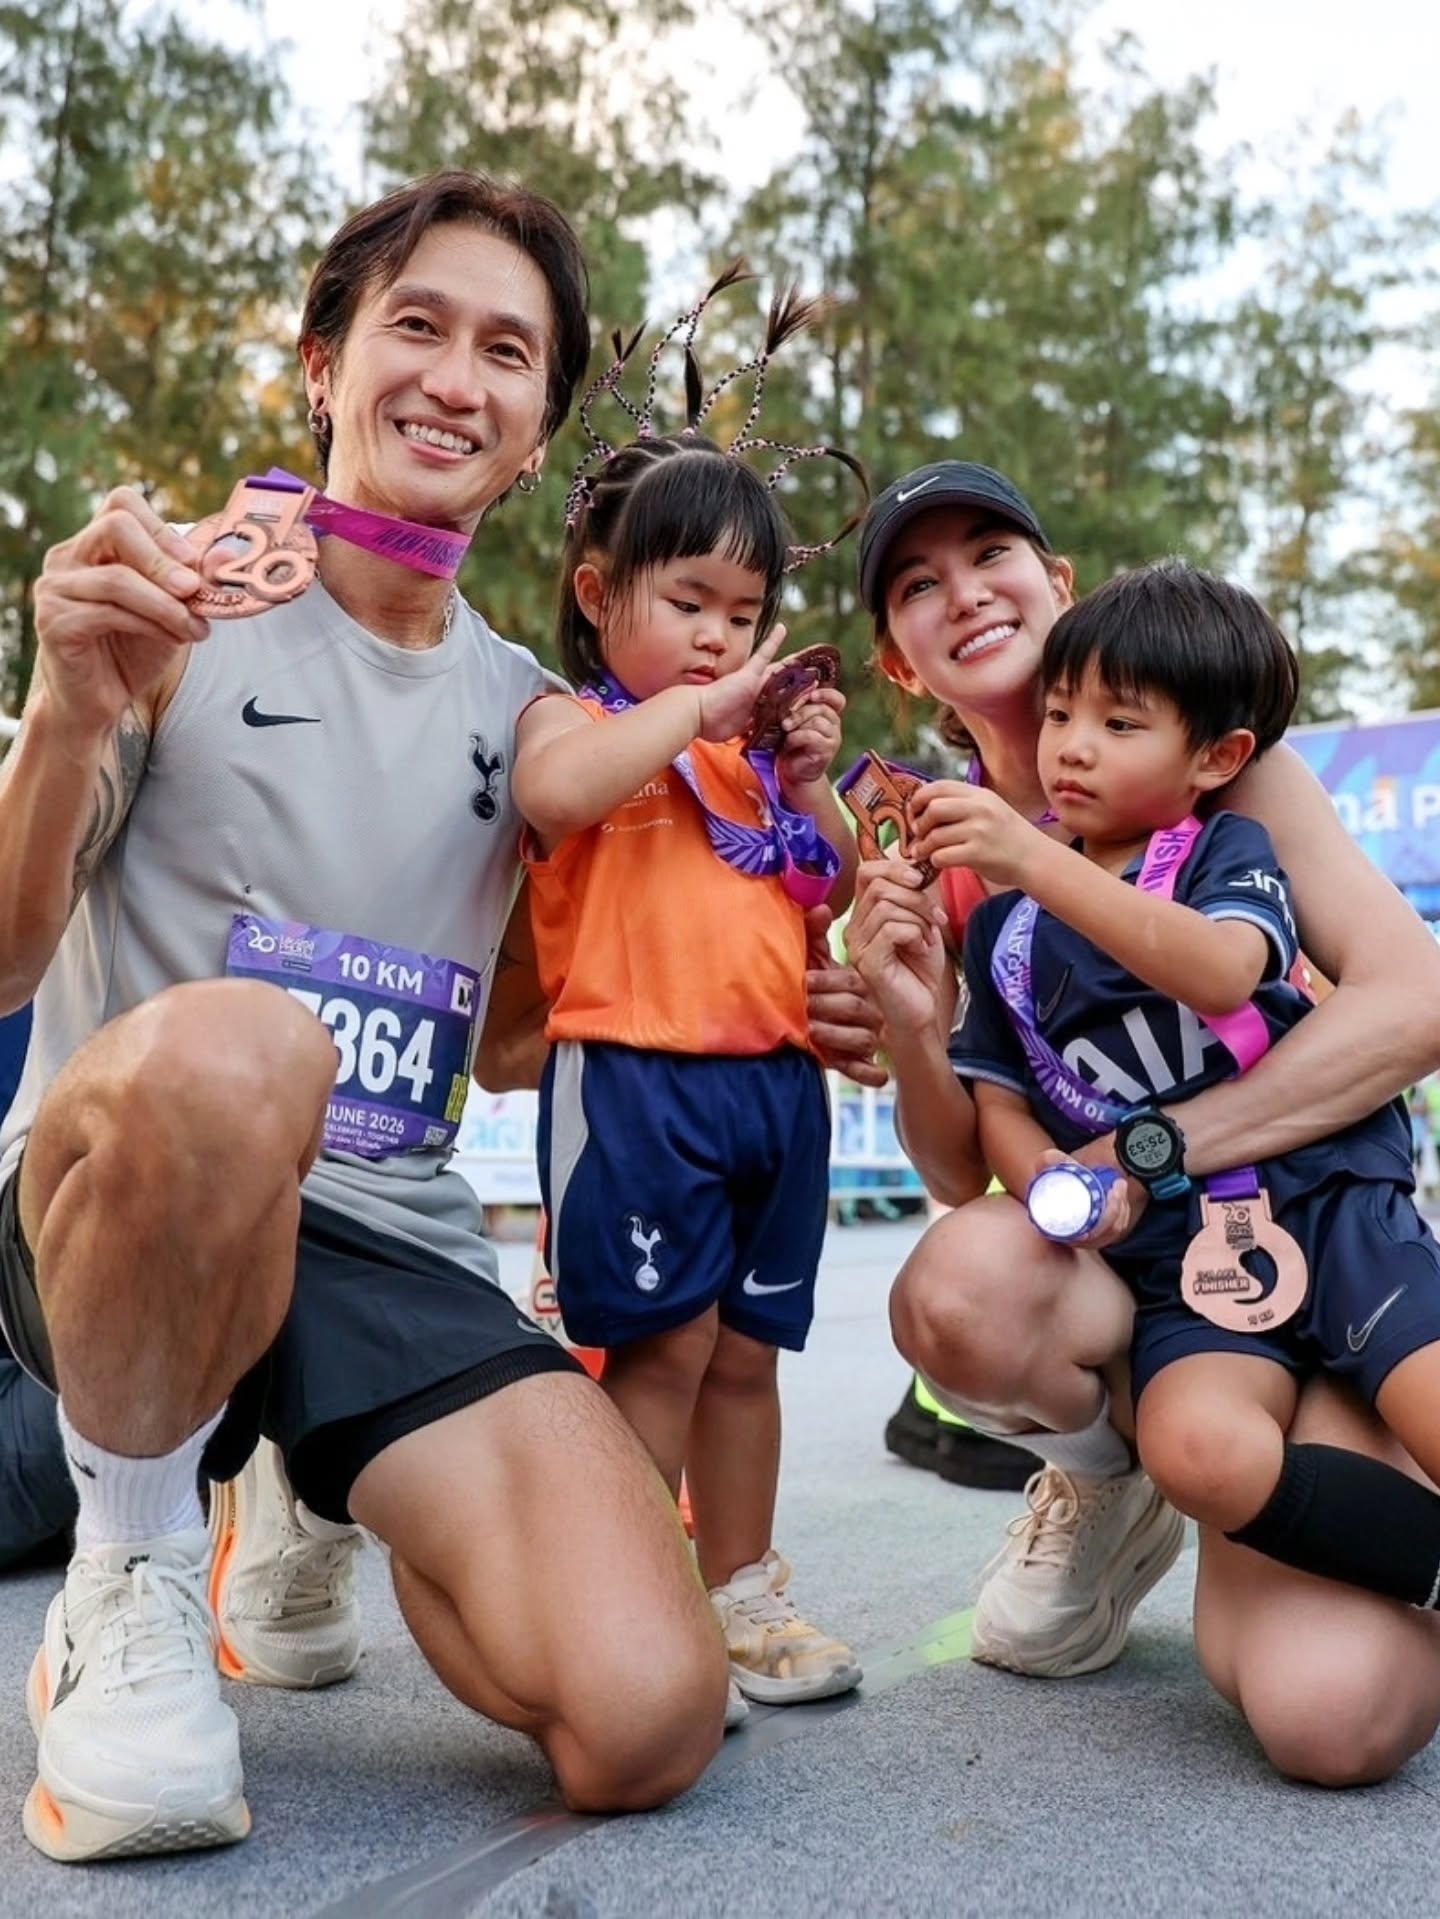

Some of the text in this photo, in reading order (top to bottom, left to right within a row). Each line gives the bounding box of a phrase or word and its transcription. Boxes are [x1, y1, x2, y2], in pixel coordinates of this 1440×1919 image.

[1003, 901, 1033, 1008] MARATHO
[338, 953, 424, 995] 10 KM
[1055, 1076, 1083, 1109] KM
[325, 1103, 405, 1134] JUNE 2026
[1193, 1278, 1250, 1295] FINISHER
